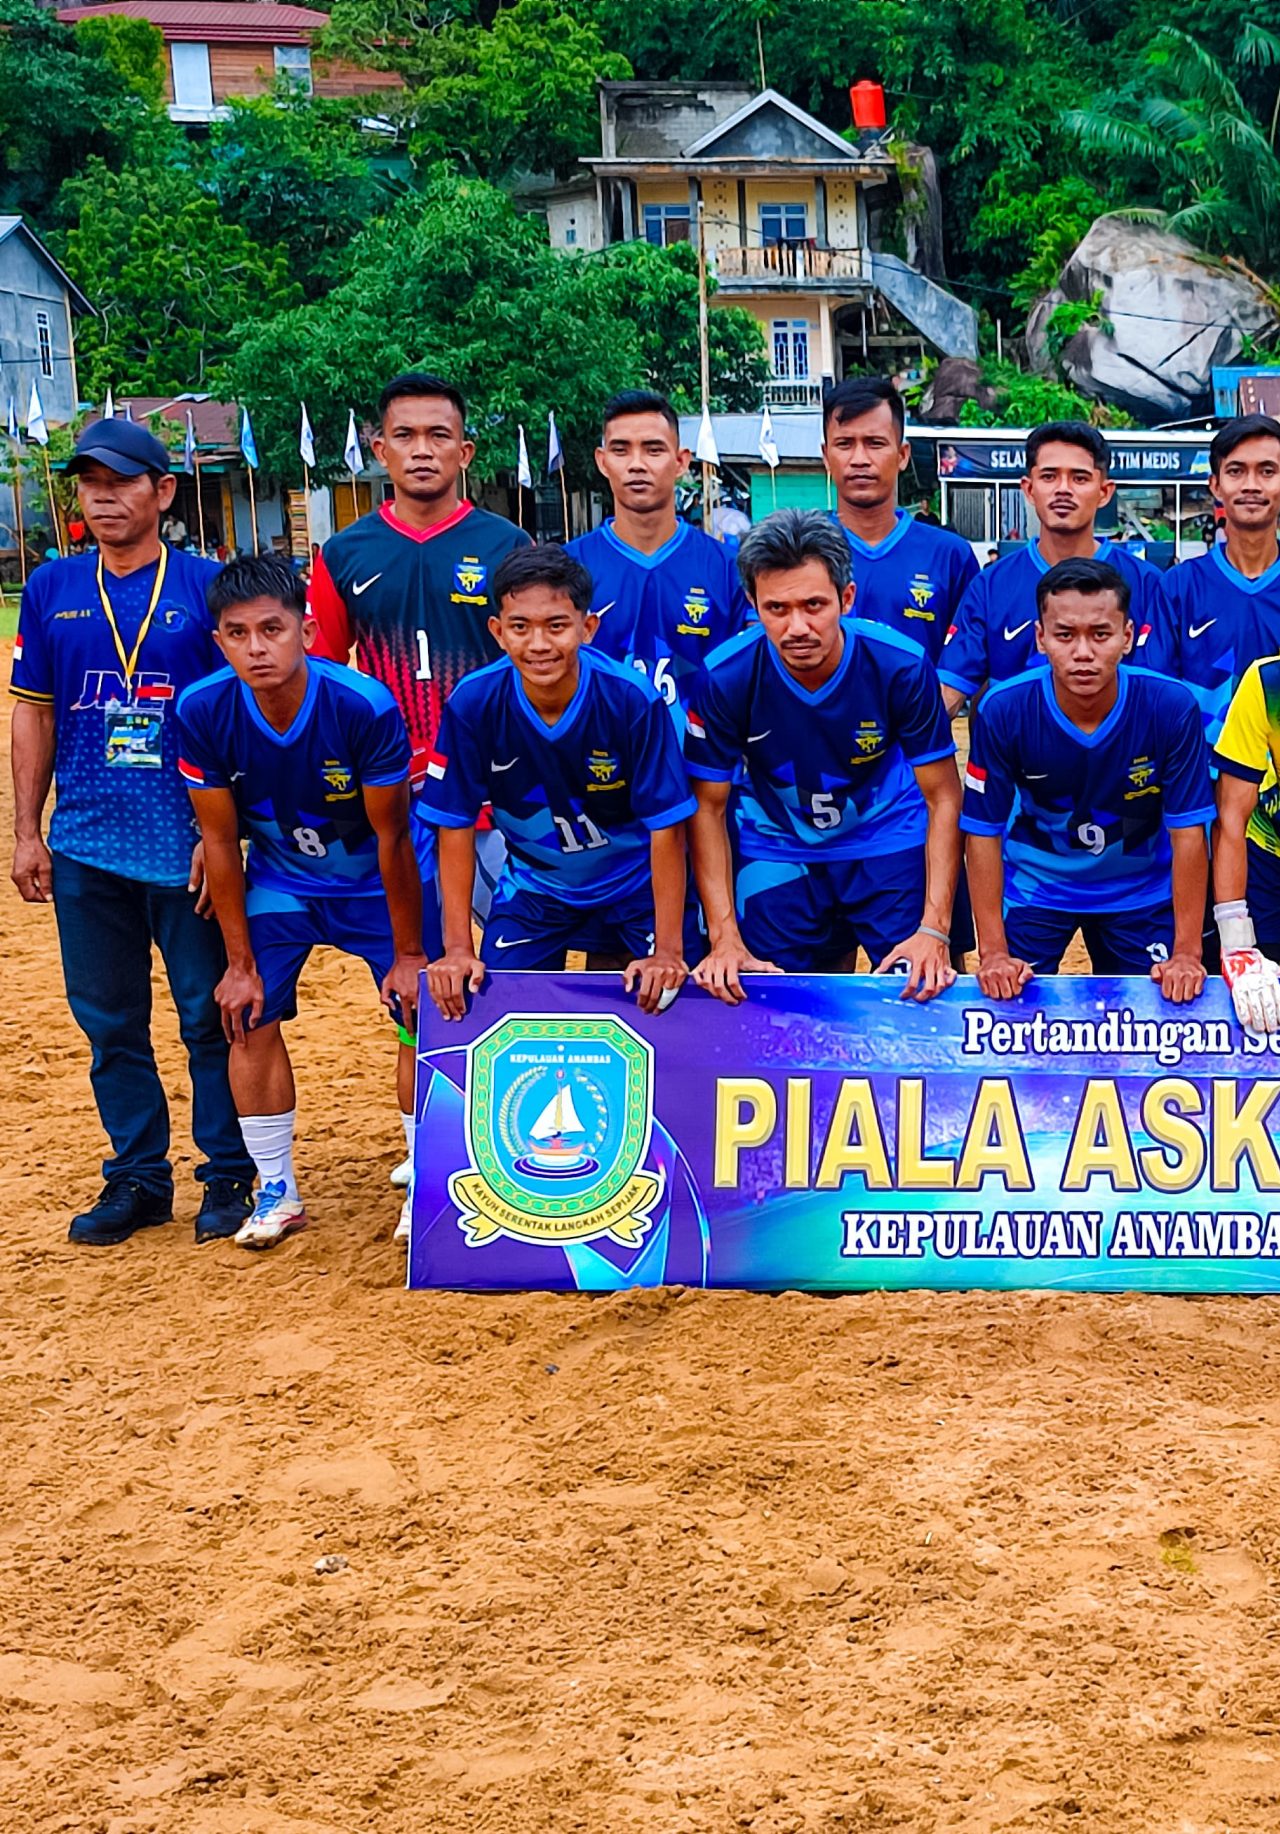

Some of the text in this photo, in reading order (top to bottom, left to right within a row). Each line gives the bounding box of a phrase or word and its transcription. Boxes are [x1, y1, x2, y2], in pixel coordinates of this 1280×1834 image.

[1118, 452, 1141, 469] TIM
[1142, 452, 1180, 469] MEDIS
[415, 629, 432, 680] 1
[70, 670, 175, 711] JNE
[811, 793, 842, 830] 5
[293, 826, 327, 858] 8
[553, 813, 609, 853] 11
[1077, 822, 1106, 855] 9
[964, 1011, 1231, 1062] Pertandingan
[713, 1077, 1032, 1190] PIALA
[471, 1182, 641, 1232] KAYUH SERENTAK LANGKAH SEPIJAK
[843, 1213, 1101, 1257] KEPULAUAN
